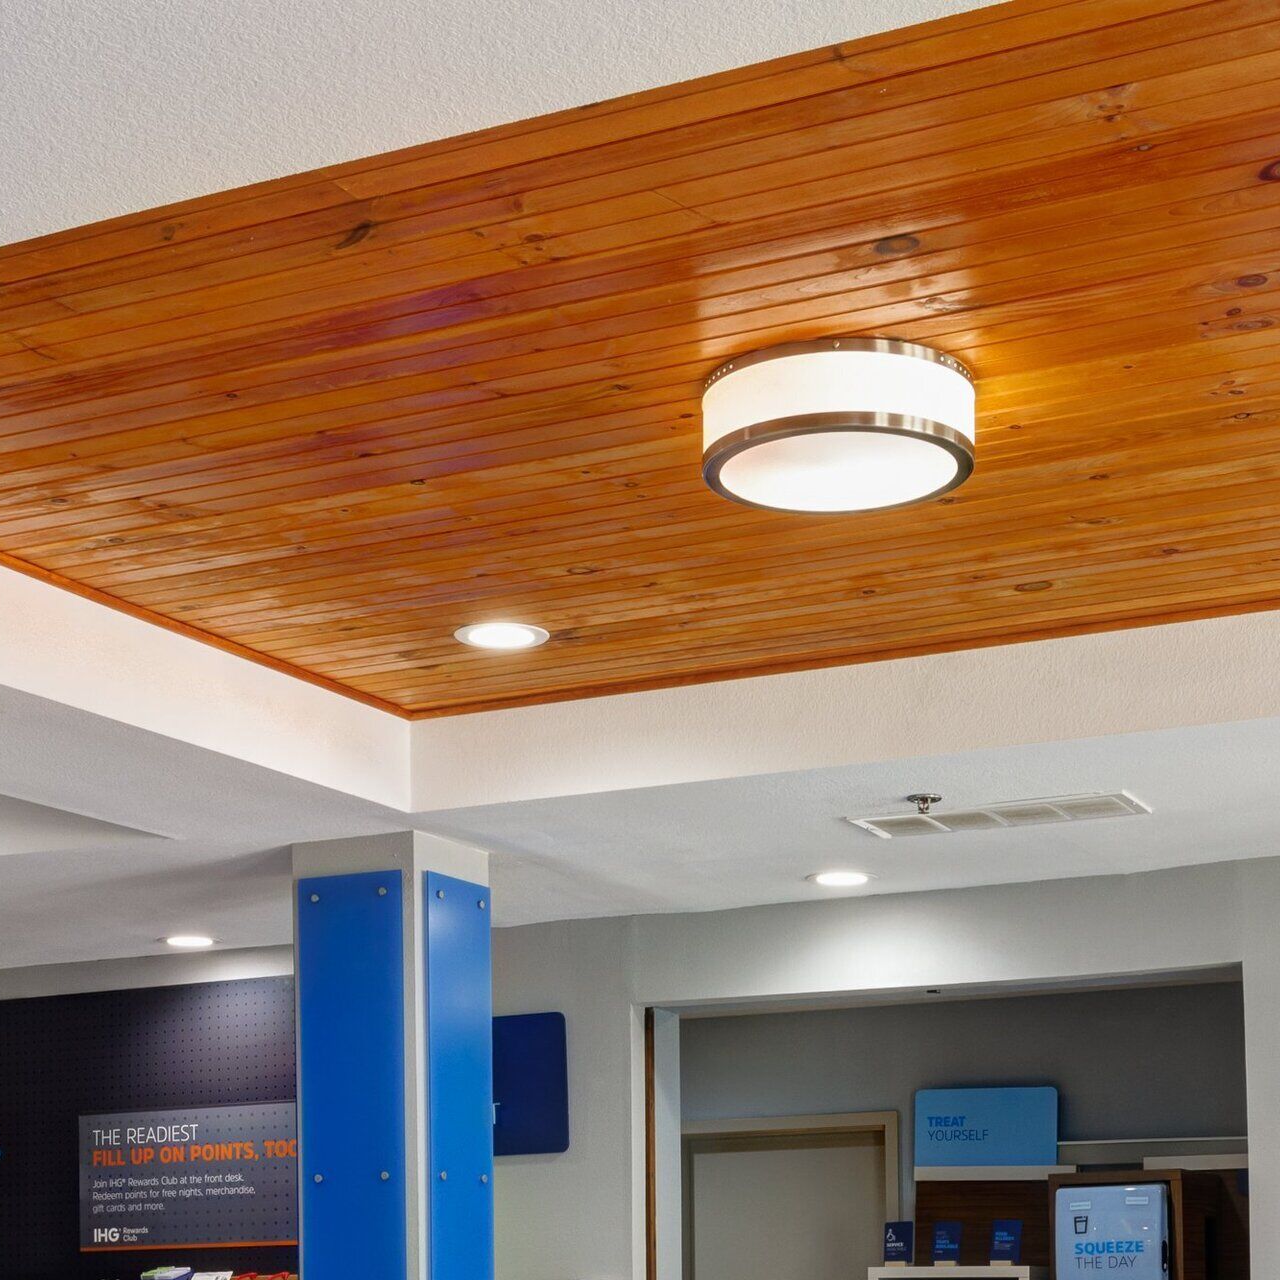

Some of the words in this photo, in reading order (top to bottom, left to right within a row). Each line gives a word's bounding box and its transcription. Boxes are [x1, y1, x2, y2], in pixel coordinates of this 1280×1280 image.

[927, 1115, 966, 1127] TREAT
[93, 1128, 121, 1146] THE
[126, 1124, 199, 1144] READIEST
[927, 1129, 989, 1141] YOURSELF
[92, 1149, 126, 1167] FILL
[131, 1147, 154, 1165] UP
[159, 1145, 186, 1163] ON
[190, 1141, 260, 1162] POINTS,
[93, 1179, 108, 1189] Join
[127, 1177, 159, 1187] Rewards
[161, 1175, 178, 1186] Club
[180, 1176, 188, 1185] at
[189, 1174, 203, 1184] the
[204, 1172, 223, 1183] front
[224, 1172, 244, 1182] desk.
[93, 1191, 123, 1201] Redeem
[124, 1190, 148, 1201] points
[149, 1188, 160, 1198] for
[161, 1187, 177, 1198] free
[178, 1187, 204, 1198] nights,
[92, 1204, 105, 1214] gift
[106, 1203, 126, 1213] cards
[127, 1202, 142, 1212] and
[143, 1201, 165, 1211] more.
[122, 1226, 149, 1235] Rewards
[122, 1234, 138, 1242] Club
[1074, 1240, 1144, 1255] SQUEEZE
[1075, 1256, 1102, 1269] THE
[1108, 1255, 1137, 1269] DAY
